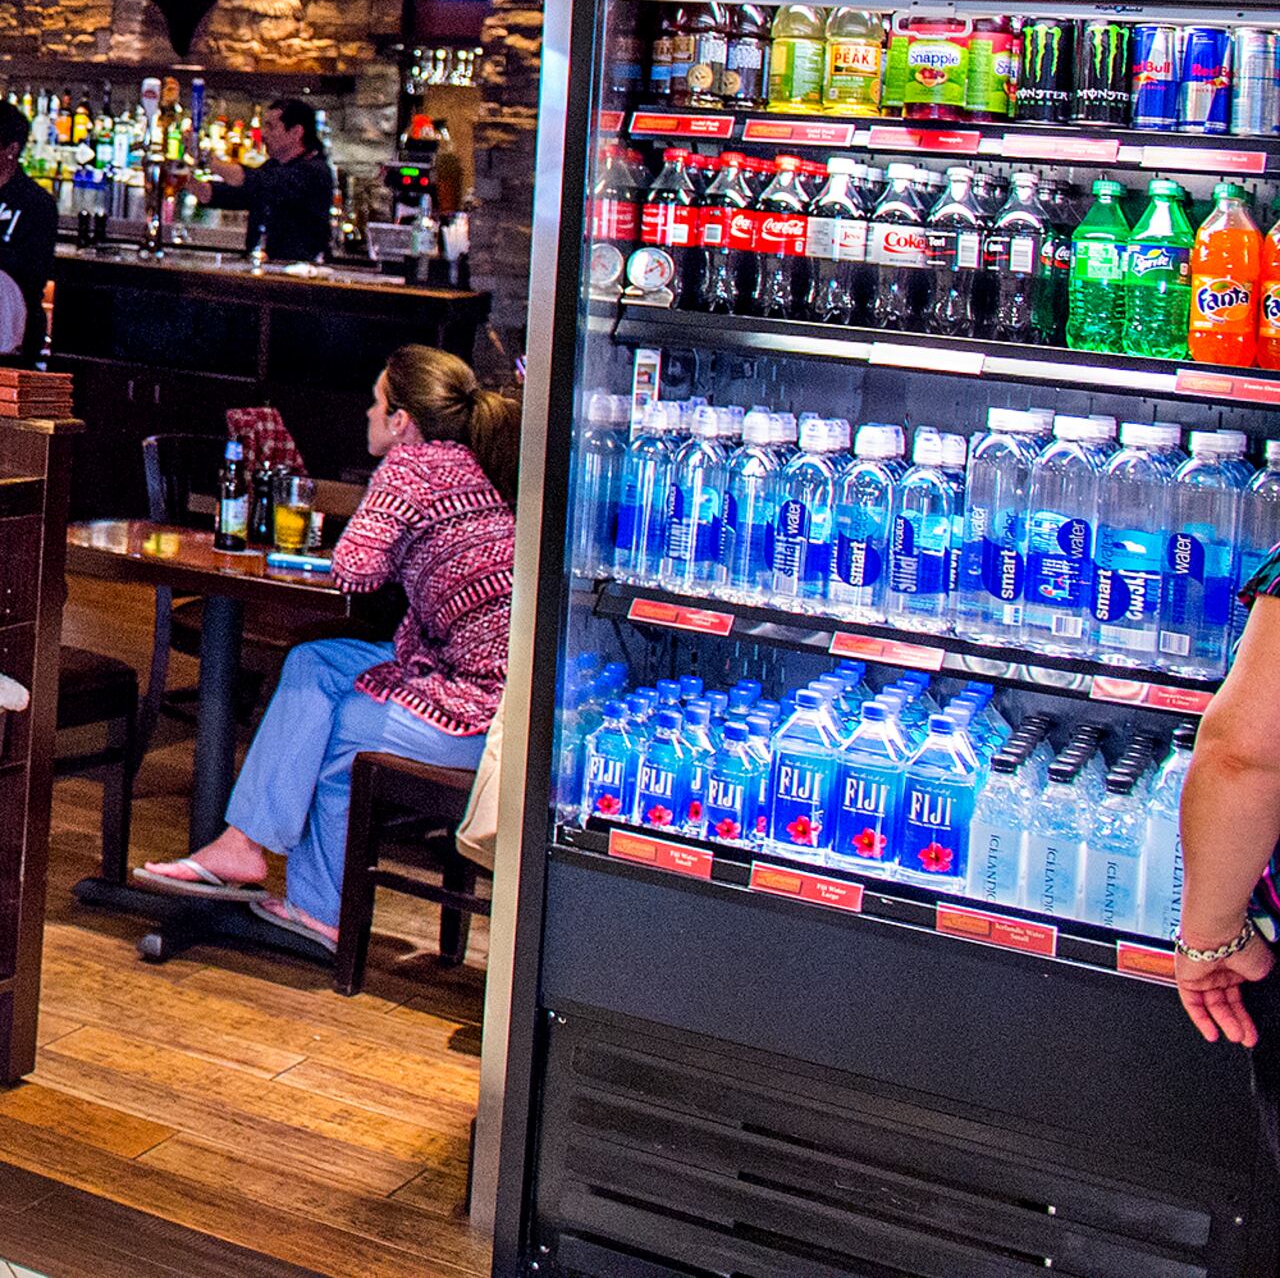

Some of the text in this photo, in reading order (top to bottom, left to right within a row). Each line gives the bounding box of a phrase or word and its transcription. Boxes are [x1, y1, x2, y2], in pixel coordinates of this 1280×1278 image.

[834, 53, 870, 65] PEAK
[910, 53, 959, 67] Snapple
[1145, 61, 1171, 73] Bull
[1077, 88, 1130, 101] MONSTE
[761, 218, 805, 236] Coca-Cola
[884, 231, 924, 250] Coke
[1136, 254, 1170, 272] Sprite
[1198, 287, 1249, 313] Fanta
[590, 756, 624, 786] FIJI
[641, 767, 676, 797] FIJI
[778, 766, 823, 803] FIJI
[708, 779, 744, 809] FIJI
[843, 778, 888, 812] FIJI
[910, 790, 952, 826] FIJI
[994, 922, 1046, 940] Icelandic Water
[1010, 931, 1030, 943] Small
